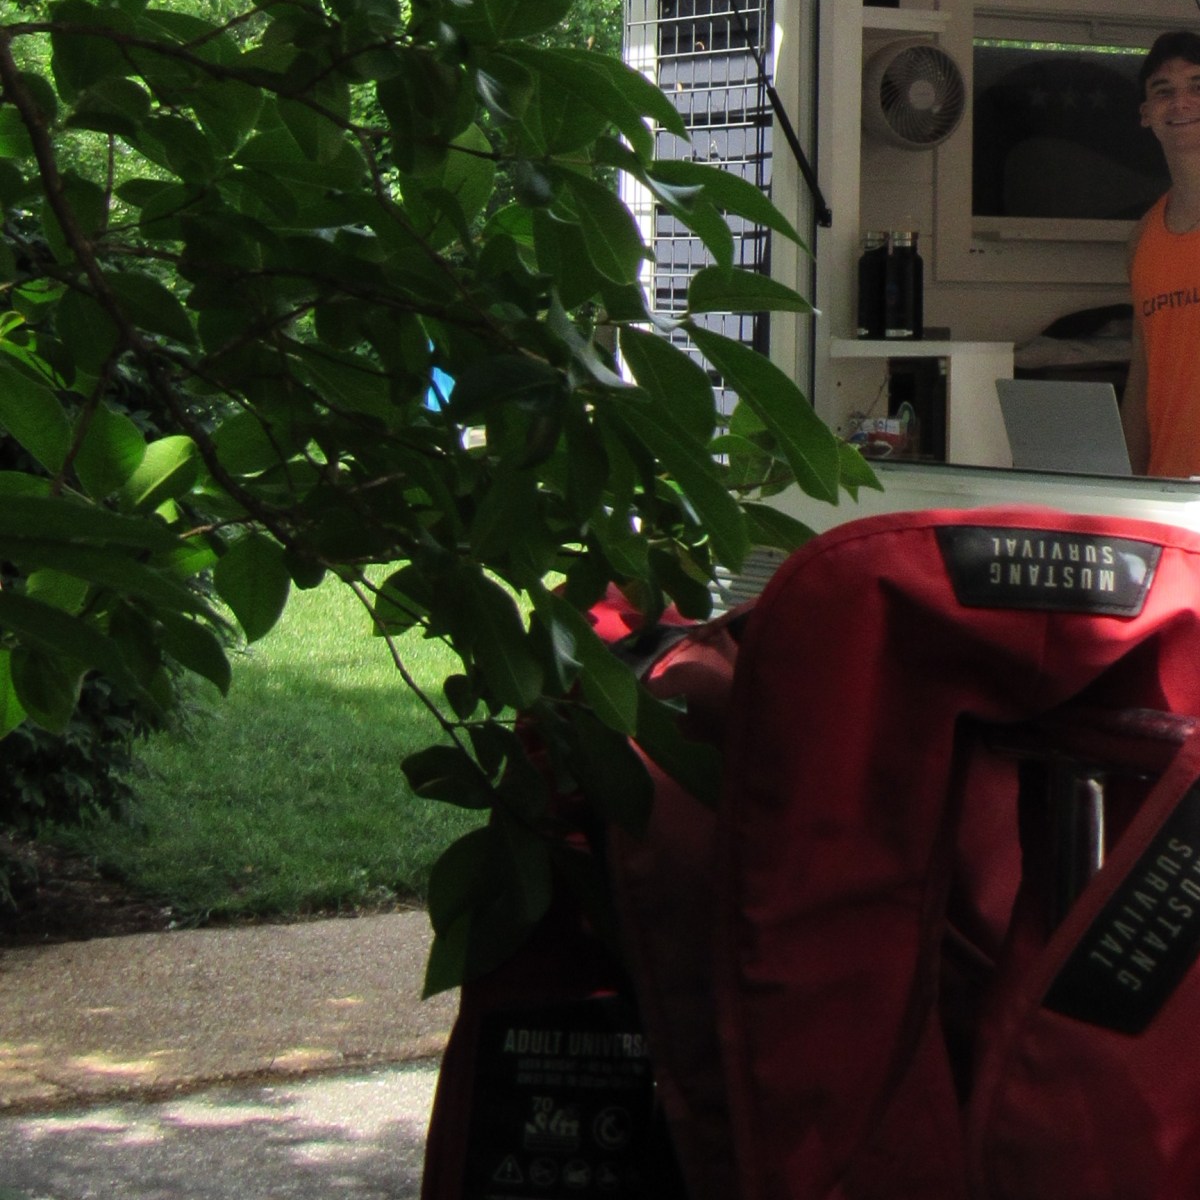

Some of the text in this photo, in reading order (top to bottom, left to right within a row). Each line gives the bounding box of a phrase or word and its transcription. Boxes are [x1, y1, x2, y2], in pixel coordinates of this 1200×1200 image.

[992, 537, 1113, 565] SURVIVAL
[990, 562, 1114, 592] MUSTANG
[1089, 837, 1193, 969] SURVIVAL
[502, 1028, 563, 1056] ADULT
